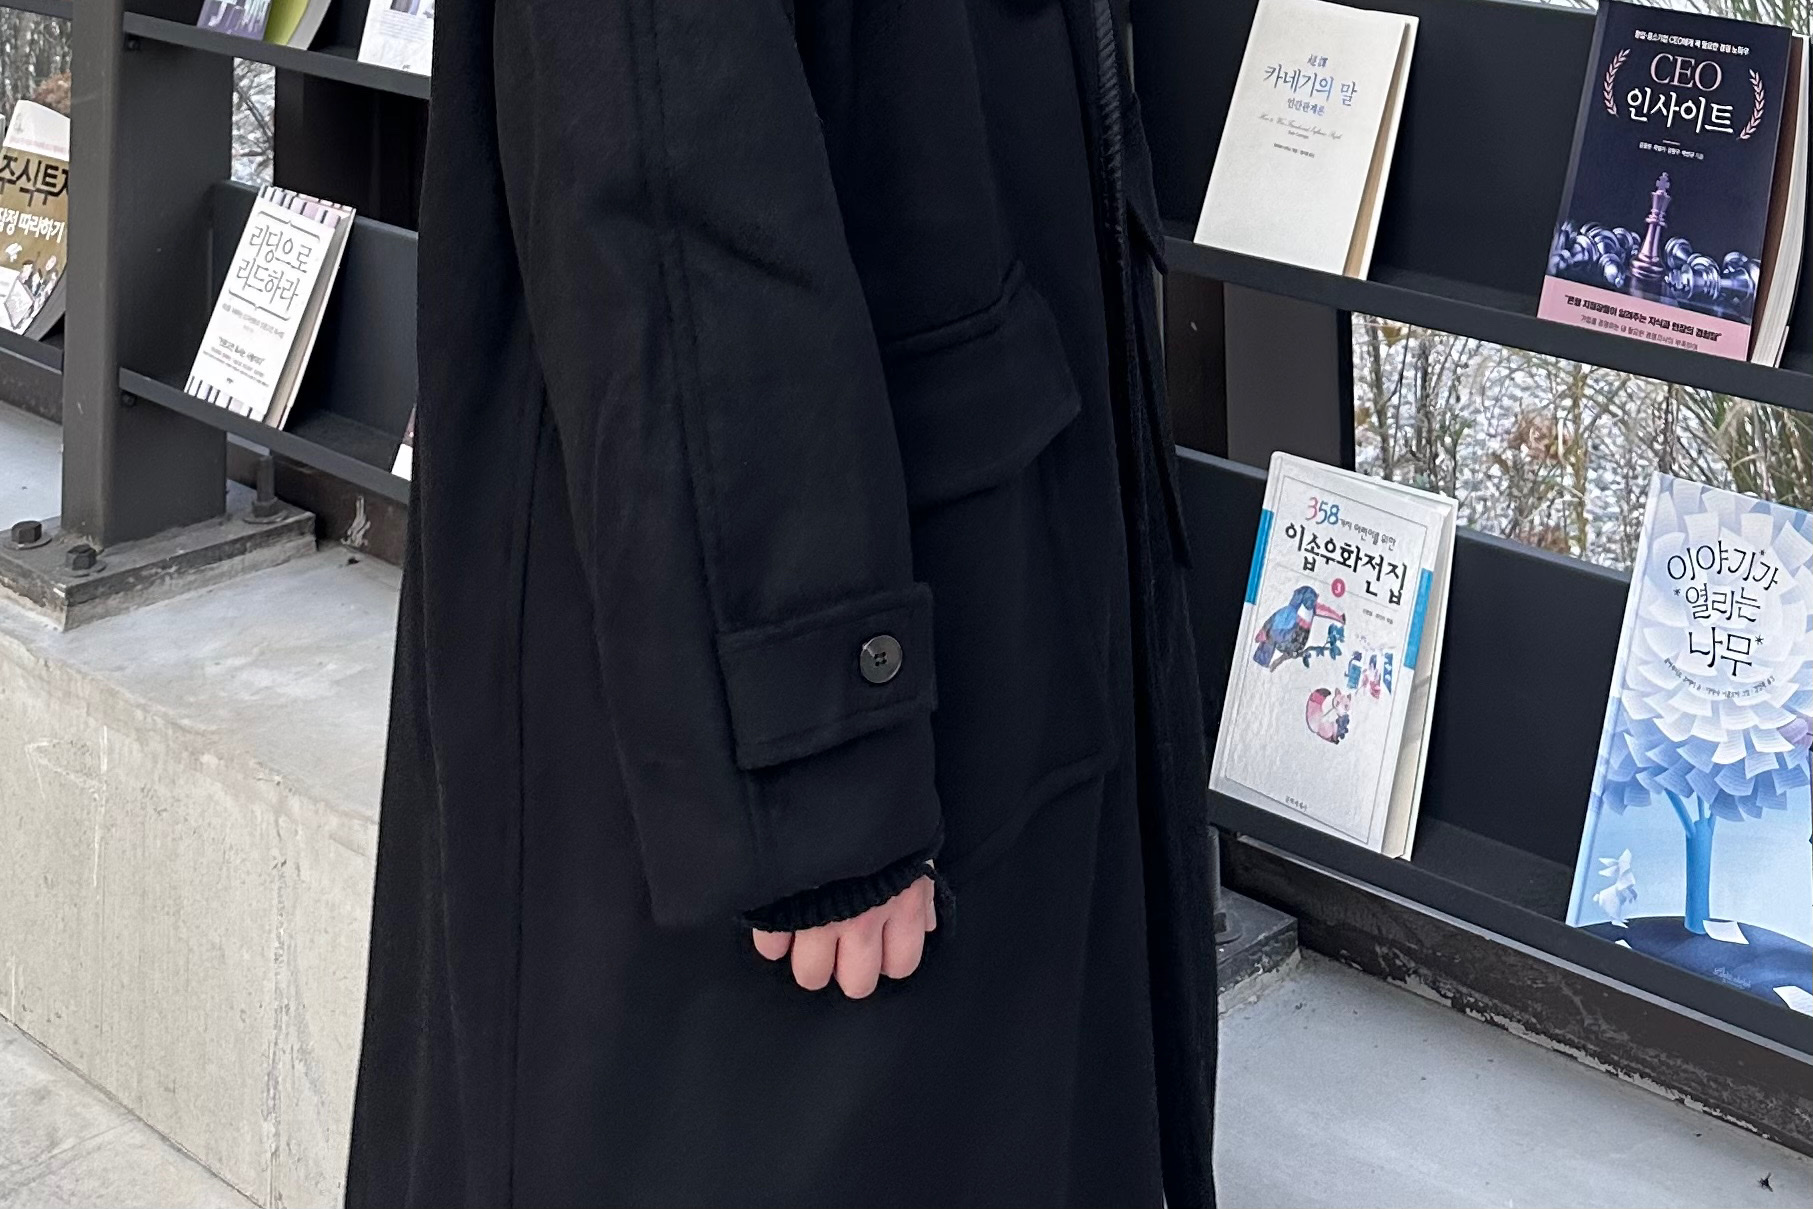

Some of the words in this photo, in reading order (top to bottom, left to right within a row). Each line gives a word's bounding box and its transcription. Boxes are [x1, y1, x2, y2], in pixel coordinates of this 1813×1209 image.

[1263, 63, 1334, 102] 카네기의
[1341, 81, 1358, 107] 말
[1650, 52, 1722, 91] CEO
[1287, 97, 1325, 117] 인간관계론
[1626, 86, 1735, 134] 인사이트
[19, 212, 65, 244] 따라하기
[250, 225, 312, 273] 리딩으로
[236, 258, 300, 313] 리드하라
[1285, 522, 1408, 606] 이솝우화전집
[1381, 534, 1397, 551] 위한
[1667, 540, 1779, 591] 이야기가
[1685, 583, 1761, 622] 열리는
[1689, 627, 1752, 676] 나무
